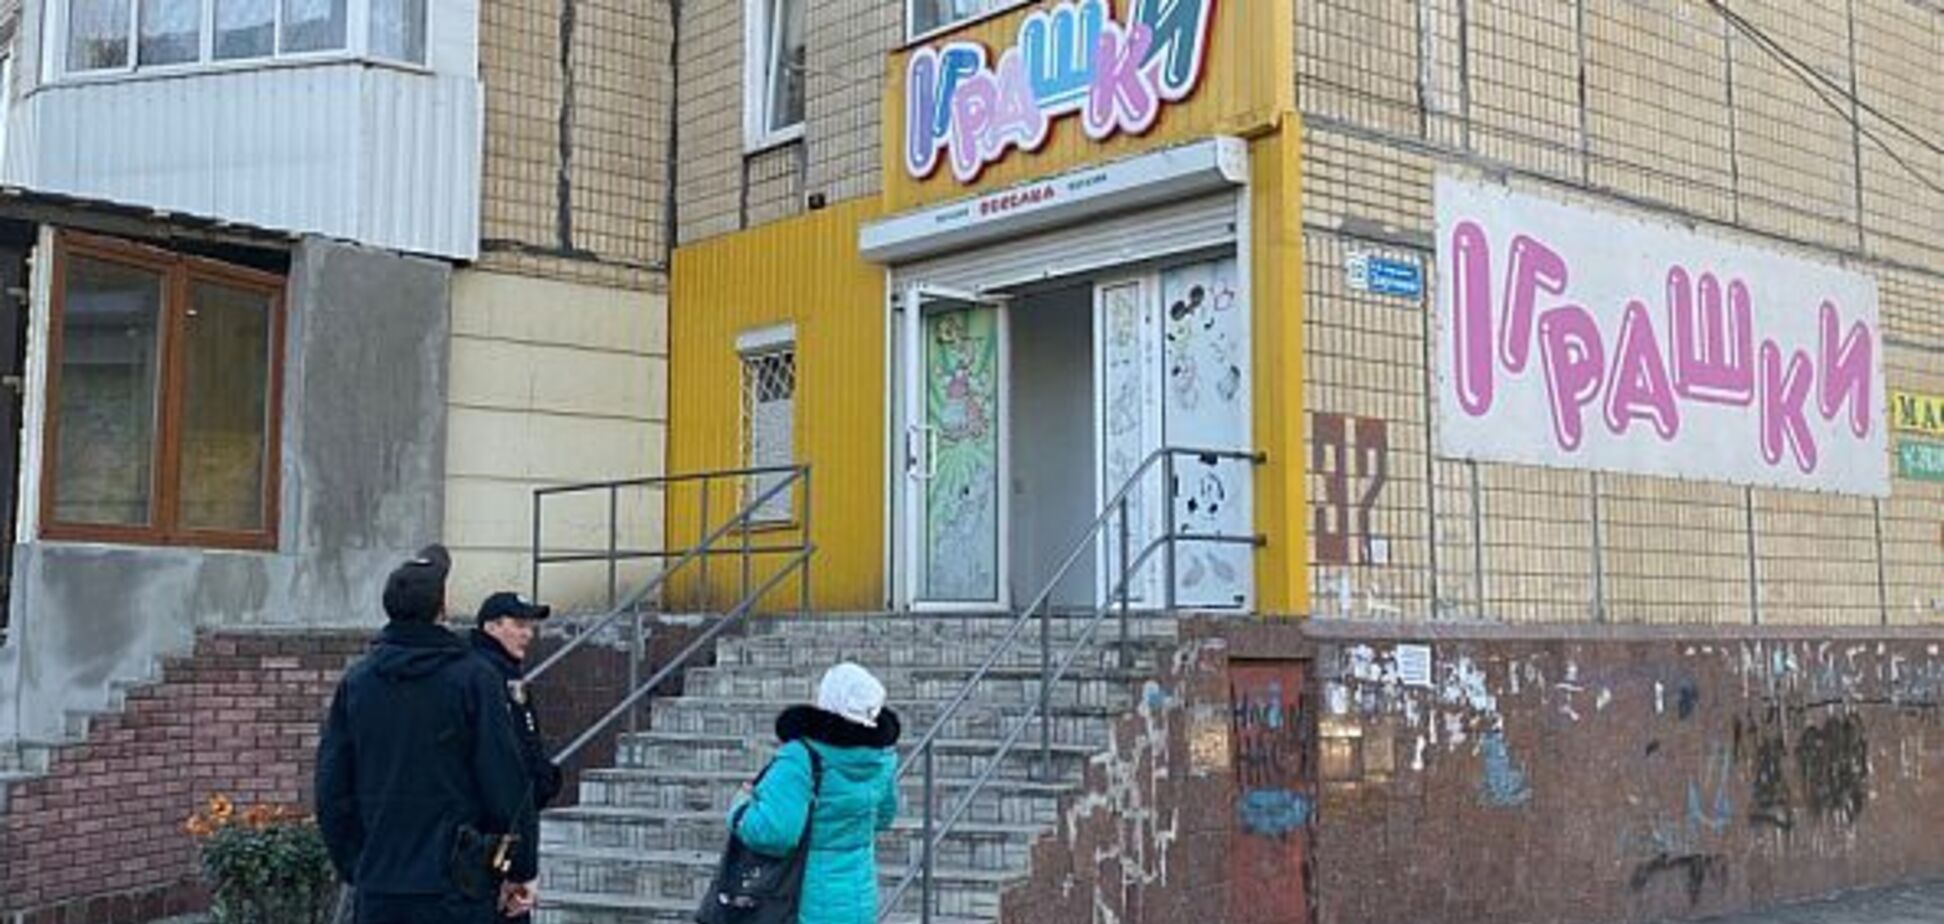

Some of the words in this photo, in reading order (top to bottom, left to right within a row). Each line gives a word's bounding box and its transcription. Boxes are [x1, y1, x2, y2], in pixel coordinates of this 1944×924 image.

[906, 0, 1208, 180] ІГРАШКИ
[1452, 220, 1873, 474] ІГРАШКИ
[1897, 394, 1944, 430] МА
[1312, 412, 1388, 566] 32
